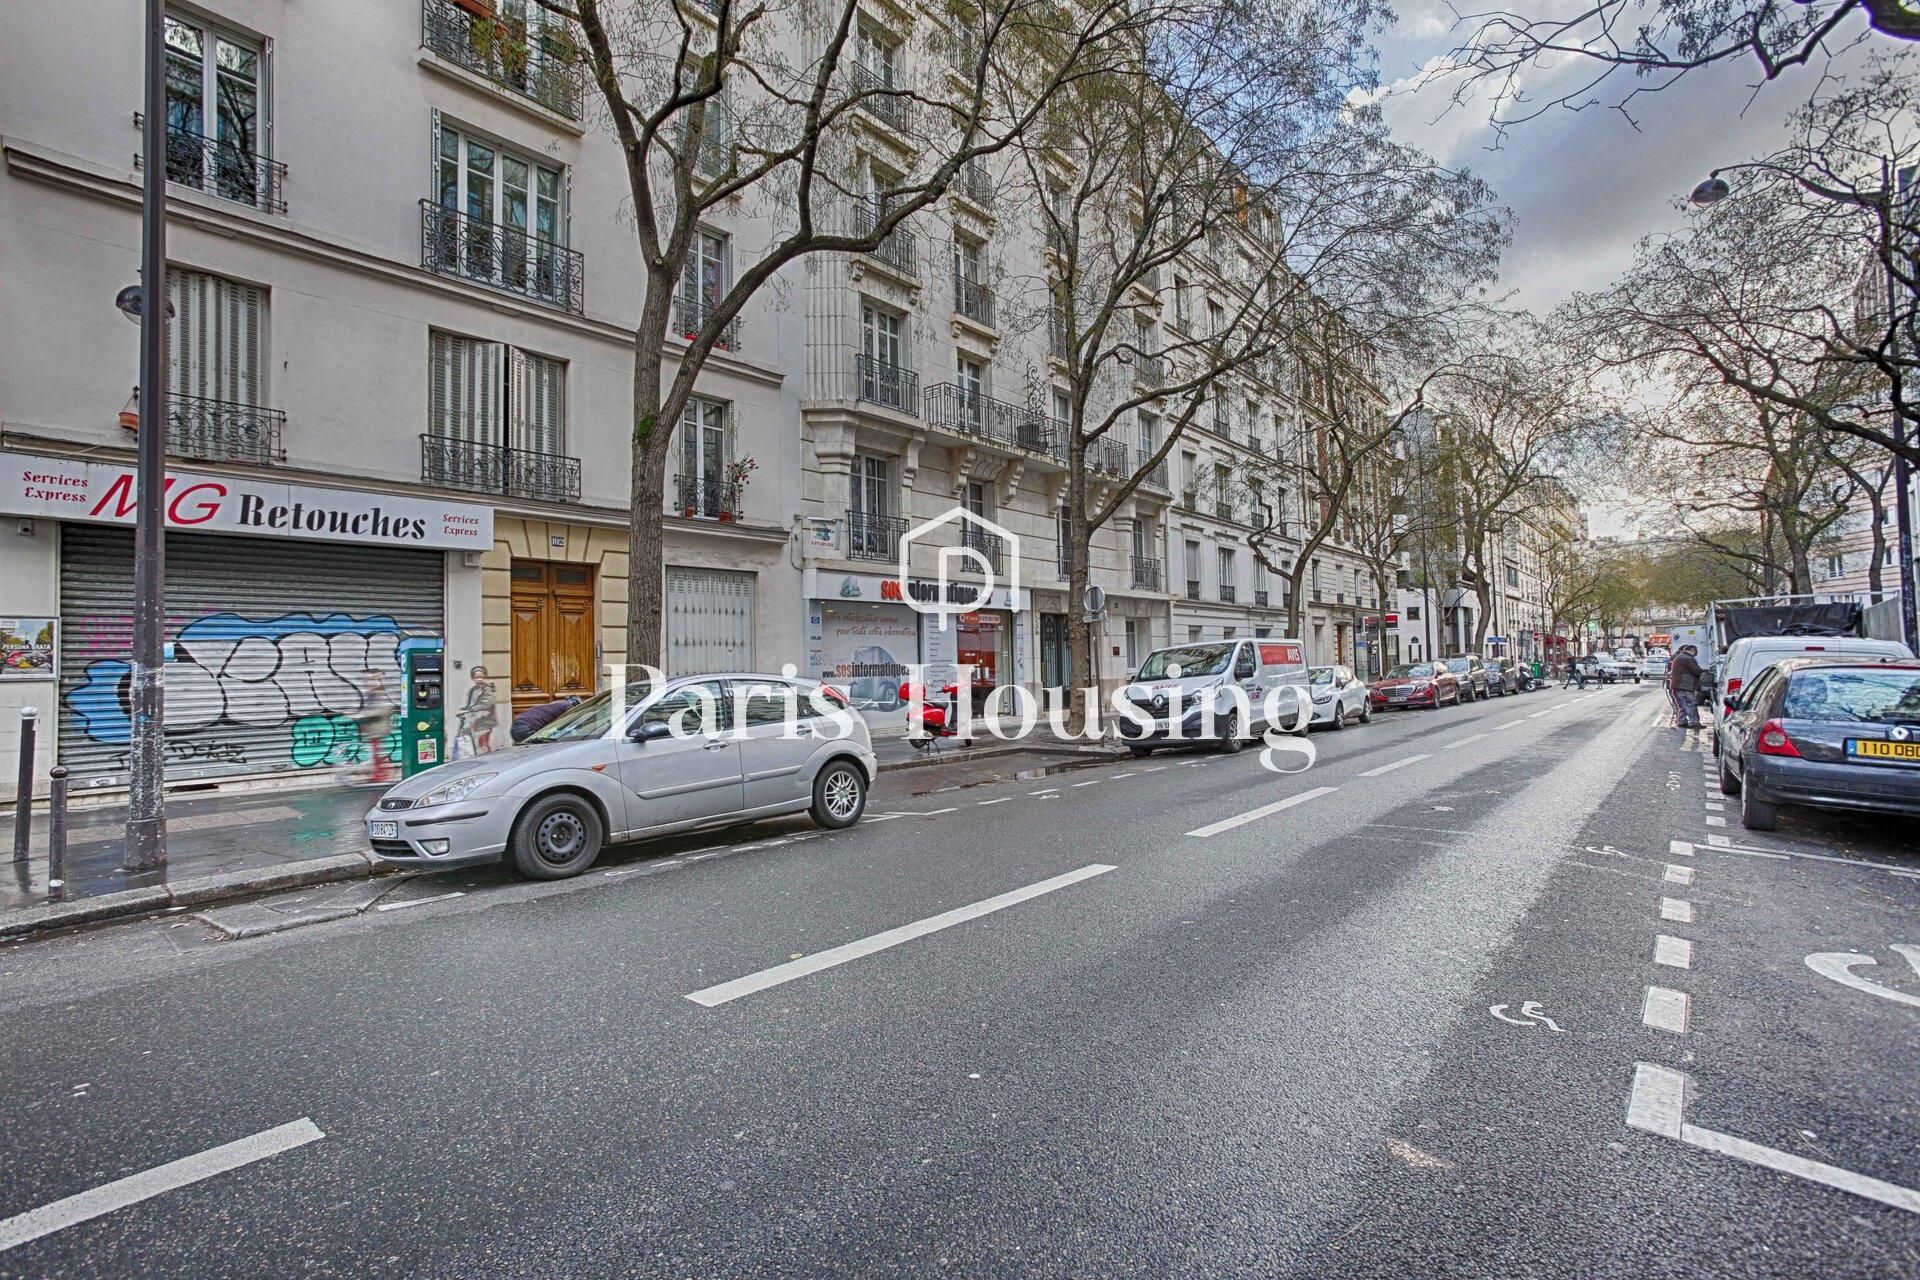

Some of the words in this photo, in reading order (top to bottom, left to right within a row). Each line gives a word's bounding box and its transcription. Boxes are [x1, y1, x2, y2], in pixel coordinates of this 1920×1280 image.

[22, 470, 89, 488] Services
[24, 486, 87, 503] Express
[89, 473, 227, 525] MG
[236, 493, 426, 540] Retouches
[442, 513, 479, 525] Services
[443, 525, 478, 537] Express
[1287, 648, 1300, 662] AVIS
